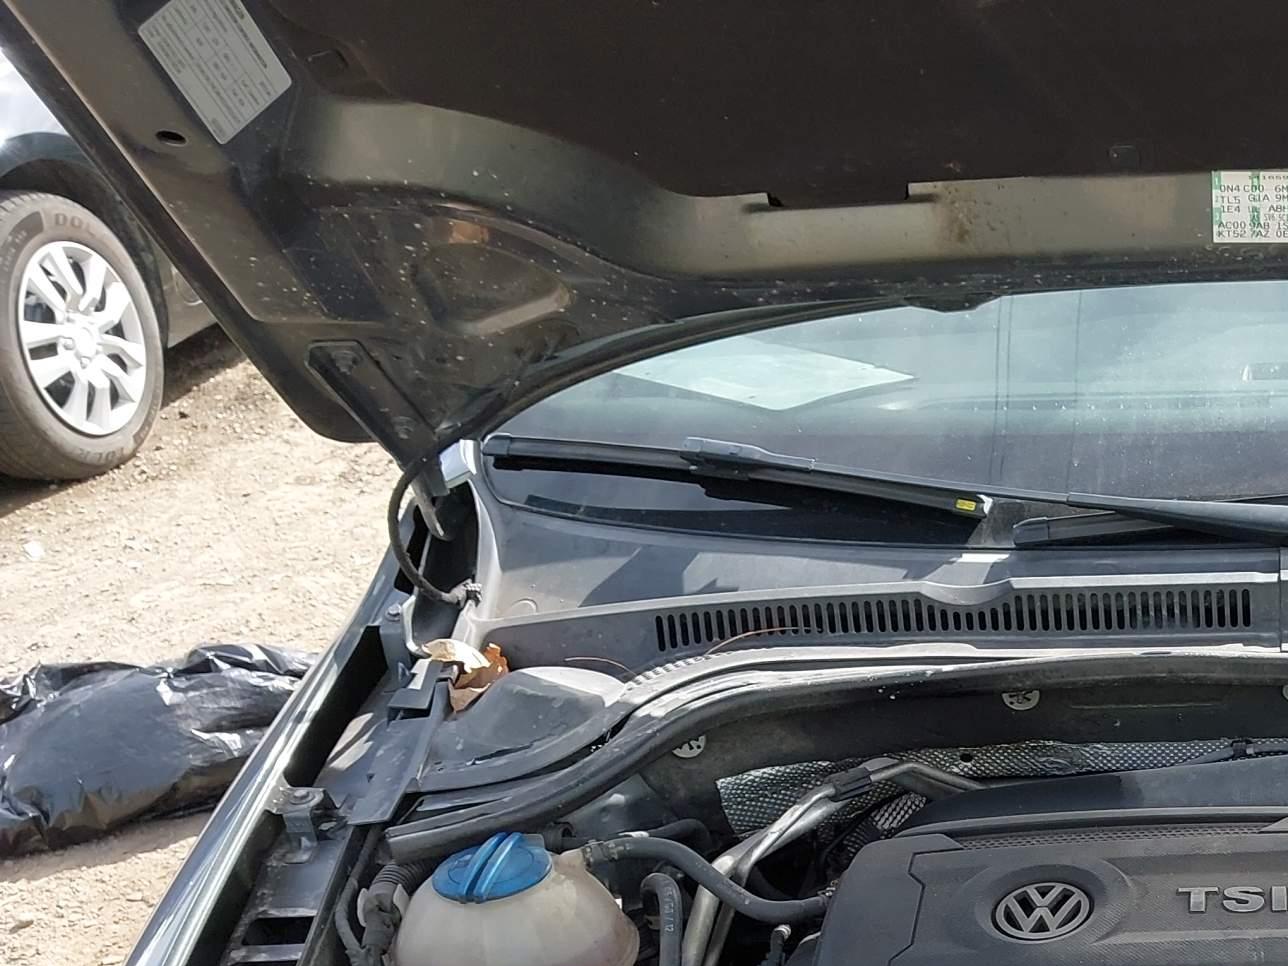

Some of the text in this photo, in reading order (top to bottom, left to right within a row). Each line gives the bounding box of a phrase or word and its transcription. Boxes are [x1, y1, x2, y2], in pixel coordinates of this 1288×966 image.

[1243, 184, 1264, 192] C00
[1220, 205, 1240, 213] 1E4
[1217, 221, 1246, 229] AC00
[1176, 885, 1288, 914] TSI
[996, 882, 1090, 939] VW
